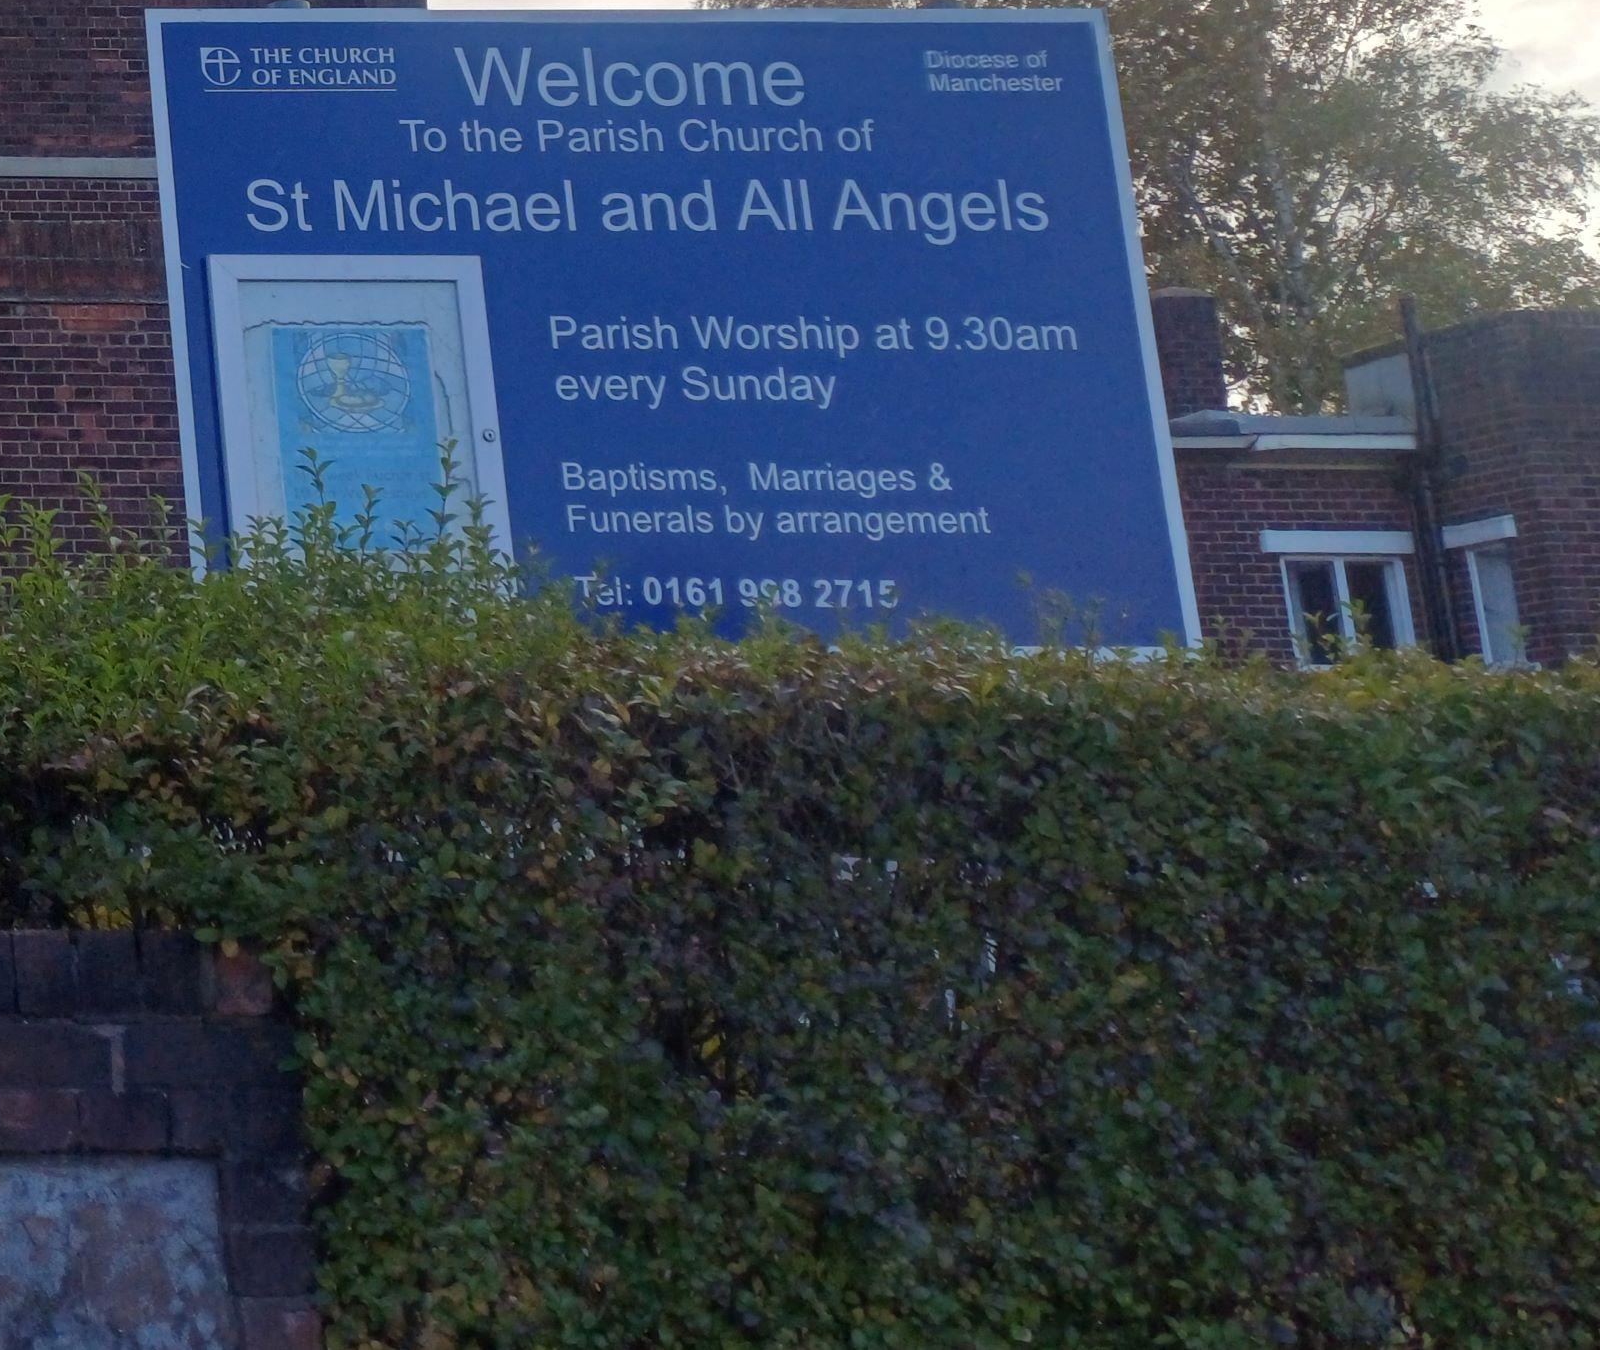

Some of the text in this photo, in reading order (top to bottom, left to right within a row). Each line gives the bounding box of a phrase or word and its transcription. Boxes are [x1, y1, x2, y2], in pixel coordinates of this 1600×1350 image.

[249, 46, 395, 65] THE CHURCH
[925, 49, 1048, 69] Diocese of
[251, 68, 397, 86] OF ENGLAND
[453, 46, 805, 107] Welcome
[928, 73, 1064, 92] Manchester
[398, 118, 875, 153] To the Parish Church of
[246, 178, 1050, 246] St Michael and All Angels
[549, 315, 1078, 359] Parish Worship at 9.30am
[555, 365, 836, 410] every Sunday
[561, 461, 953, 499] Baptisms, Marriages &
[566, 504, 992, 542] Funerals by arrangement
[643, 576, 724, 609] 0161
[813, 579, 899, 609] 2715
